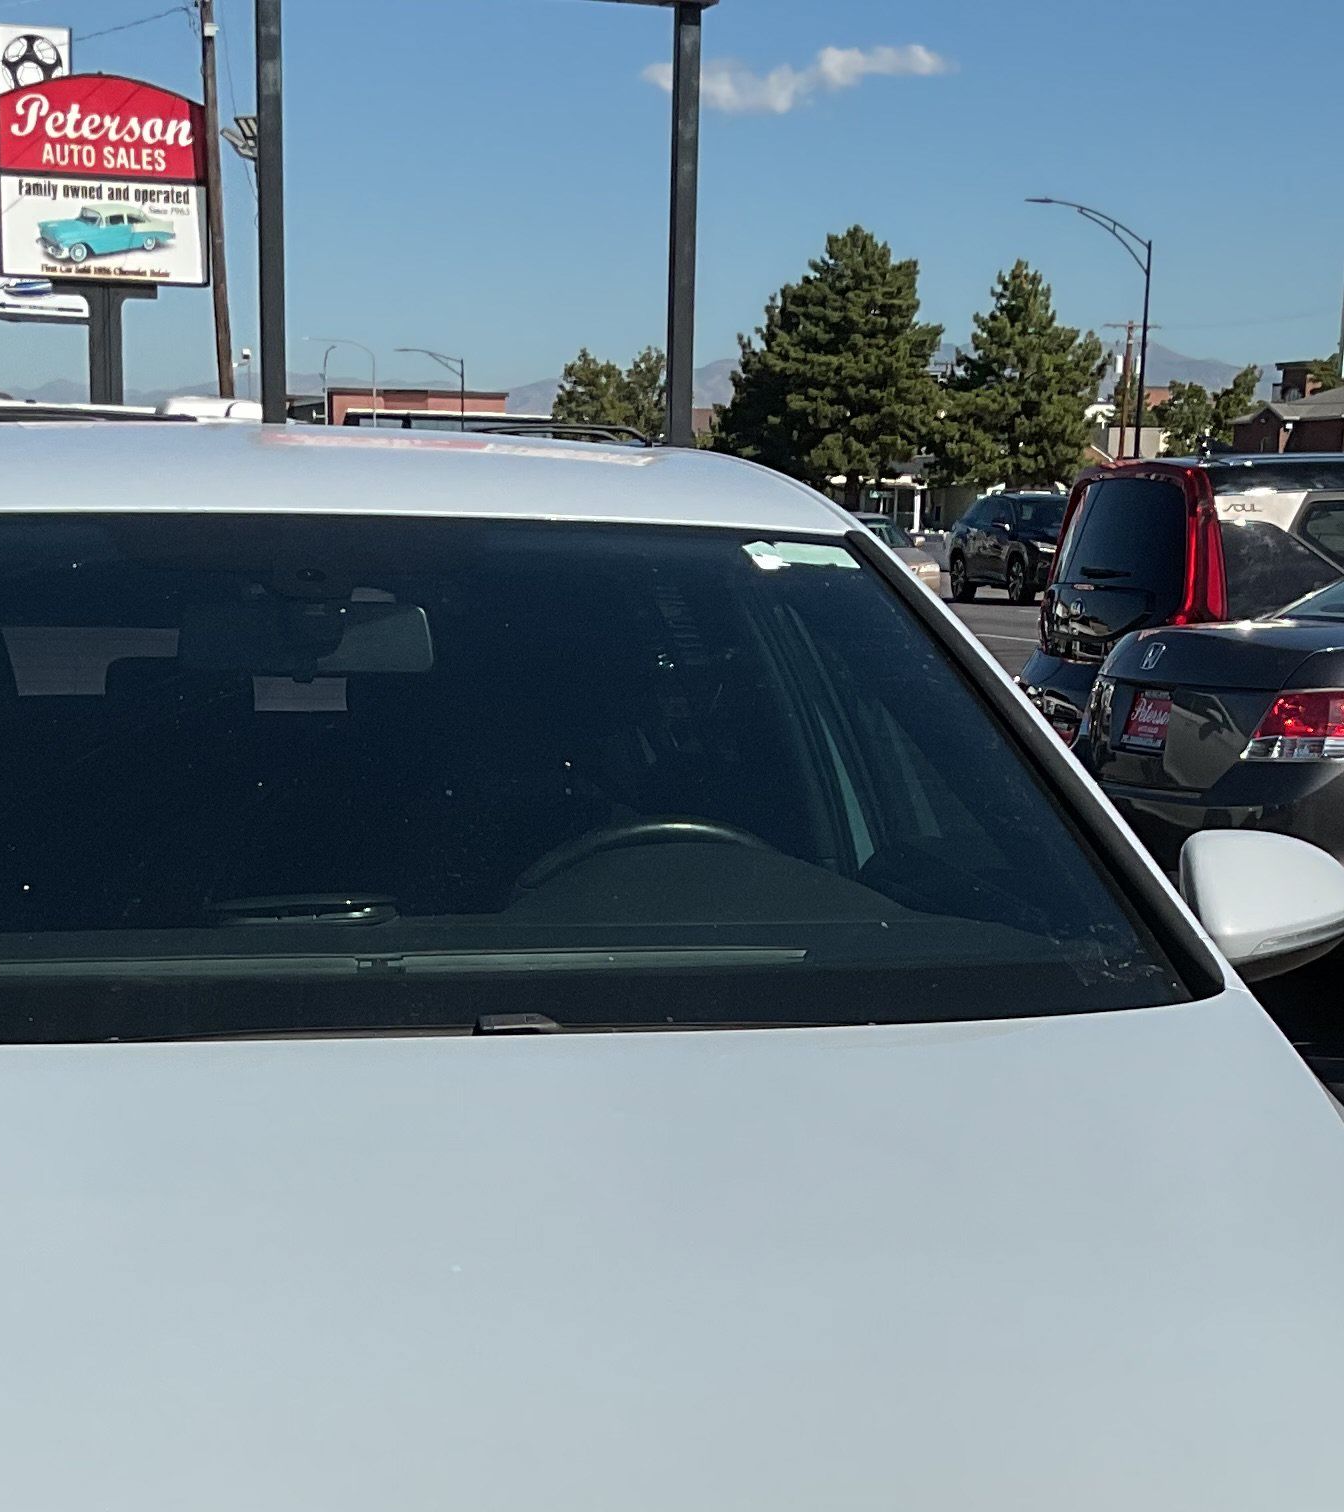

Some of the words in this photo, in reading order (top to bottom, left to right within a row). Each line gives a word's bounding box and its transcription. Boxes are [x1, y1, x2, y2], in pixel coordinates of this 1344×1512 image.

[10, 93, 194, 147] Peterson
[42, 143, 96, 167] AUTO
[104, 146, 167, 172] SALES
[18, 179, 58, 200] Family
[63, 184, 103, 200] owned
[108, 184, 130, 200] and
[134, 186, 190, 205] operated
[1131, 698, 1169, 725] Peterso
